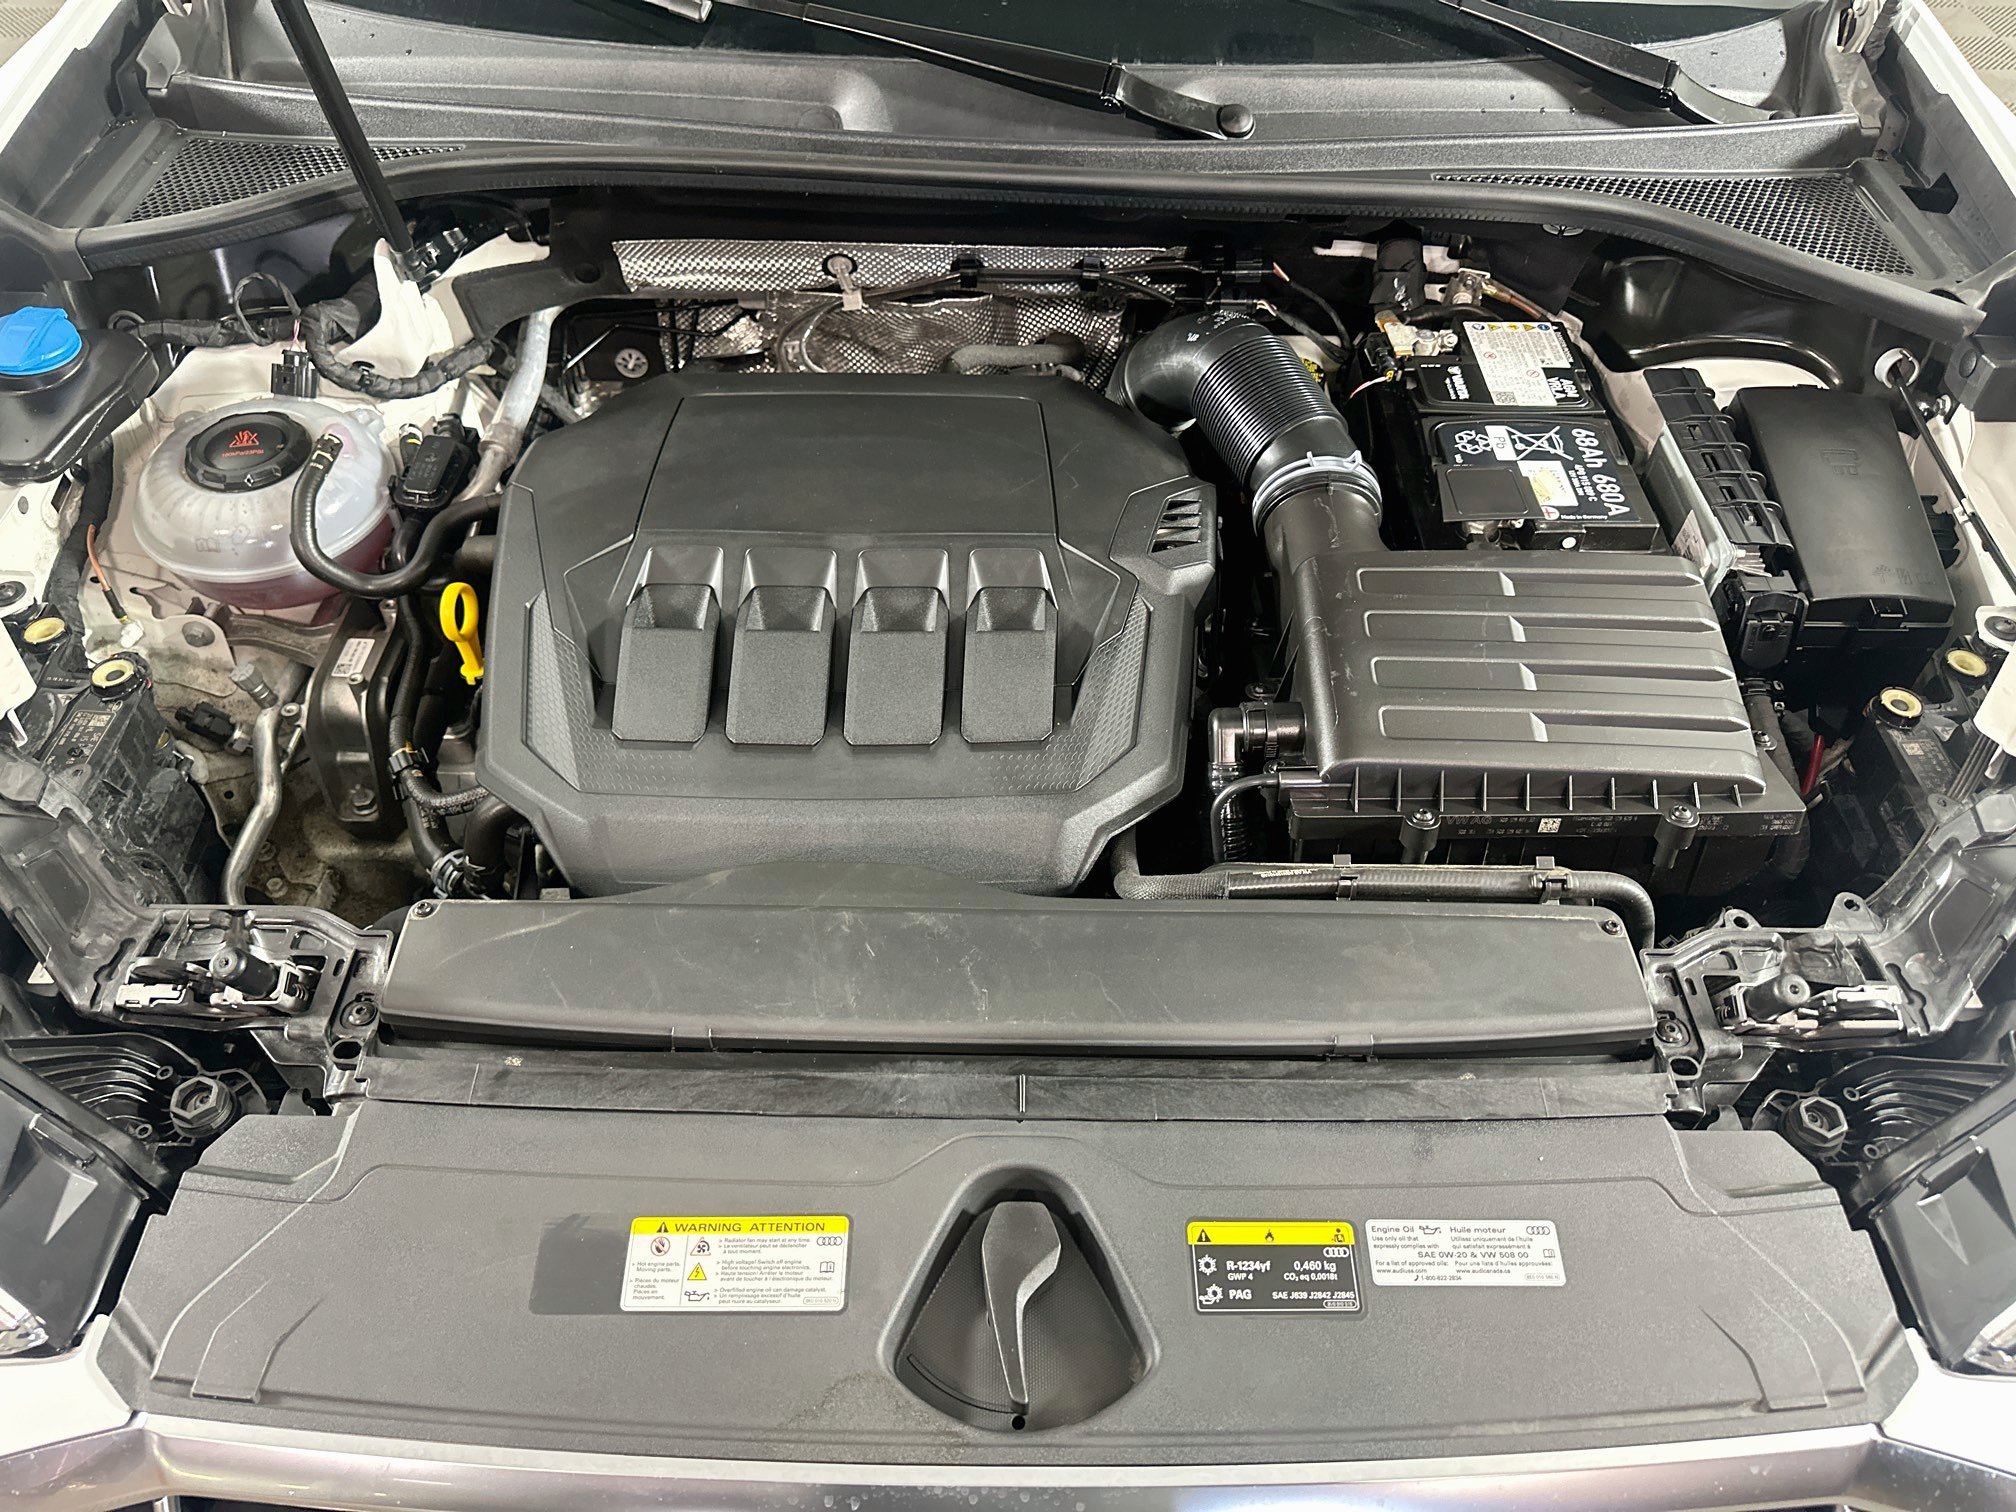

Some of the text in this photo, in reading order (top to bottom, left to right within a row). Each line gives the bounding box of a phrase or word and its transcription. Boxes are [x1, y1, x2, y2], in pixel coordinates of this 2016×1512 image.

[1547, 376, 1567, 399] VRLA
[1560, 378, 1580, 397] AGM
[1493, 436, 1506, 449] Pb
[1571, 428, 1630, 516] 68Ah 680A
[675, 1222, 825, 1232] WARNING ATTENTION
[1371, 1225, 1414, 1234] Engine Oil
[1226, 1260, 1337, 1273] R-1234yf 0,460 kg
[1227, 1273, 1253, 1281] GWP 4
[1300, 1274, 1310, 1282] eq
[1229, 1289, 1252, 1300] PAG
